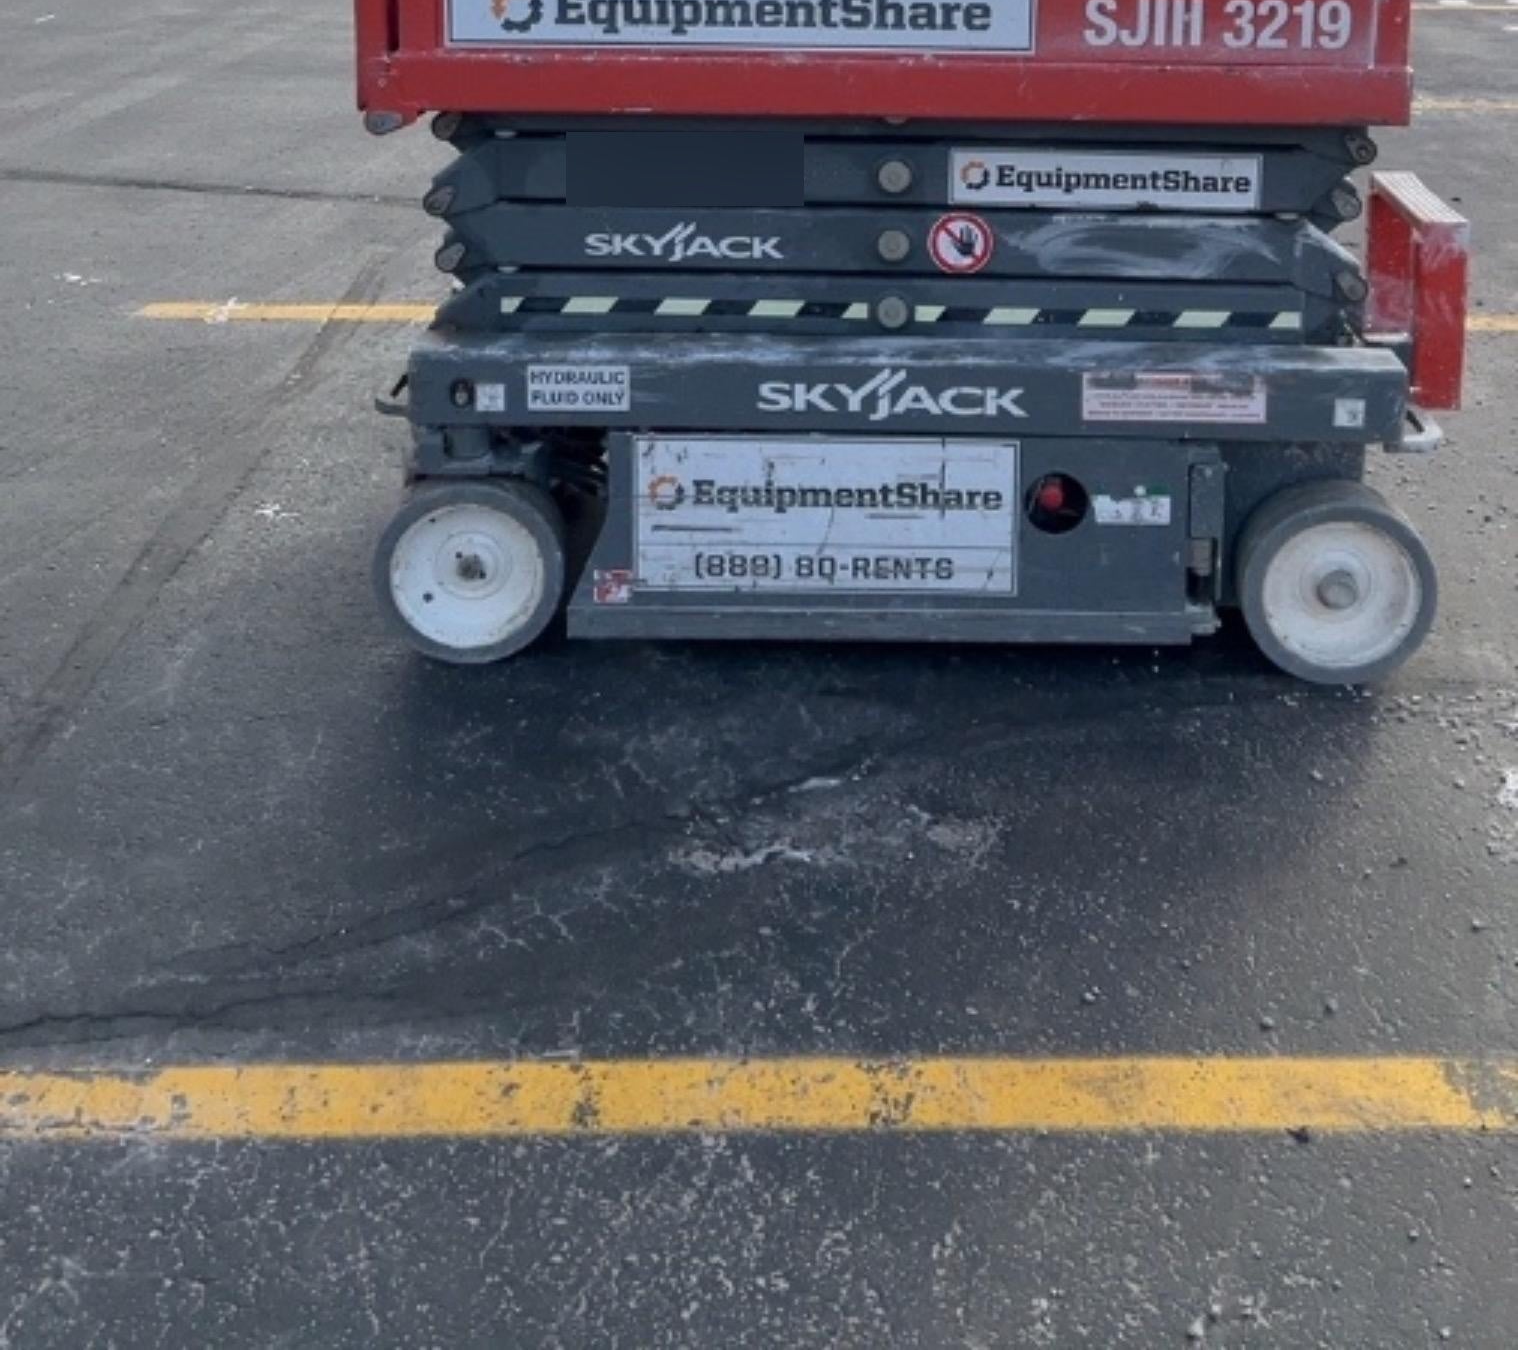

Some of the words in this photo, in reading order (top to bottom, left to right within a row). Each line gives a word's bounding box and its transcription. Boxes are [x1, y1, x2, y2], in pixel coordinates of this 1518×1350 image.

[995, 164, 1251, 193] EquipmentShare
[584, 221, 784, 262] SKYJACK
[530, 371, 625, 385] HYDRAULIC
[531, 390, 579, 406] FLUID
[582, 391, 625, 406] ONLY
[756, 368, 1030, 421] SKYJACK
[692, 479, 1003, 514] EquipmentShare
[695, 552, 782, 579] (888)
